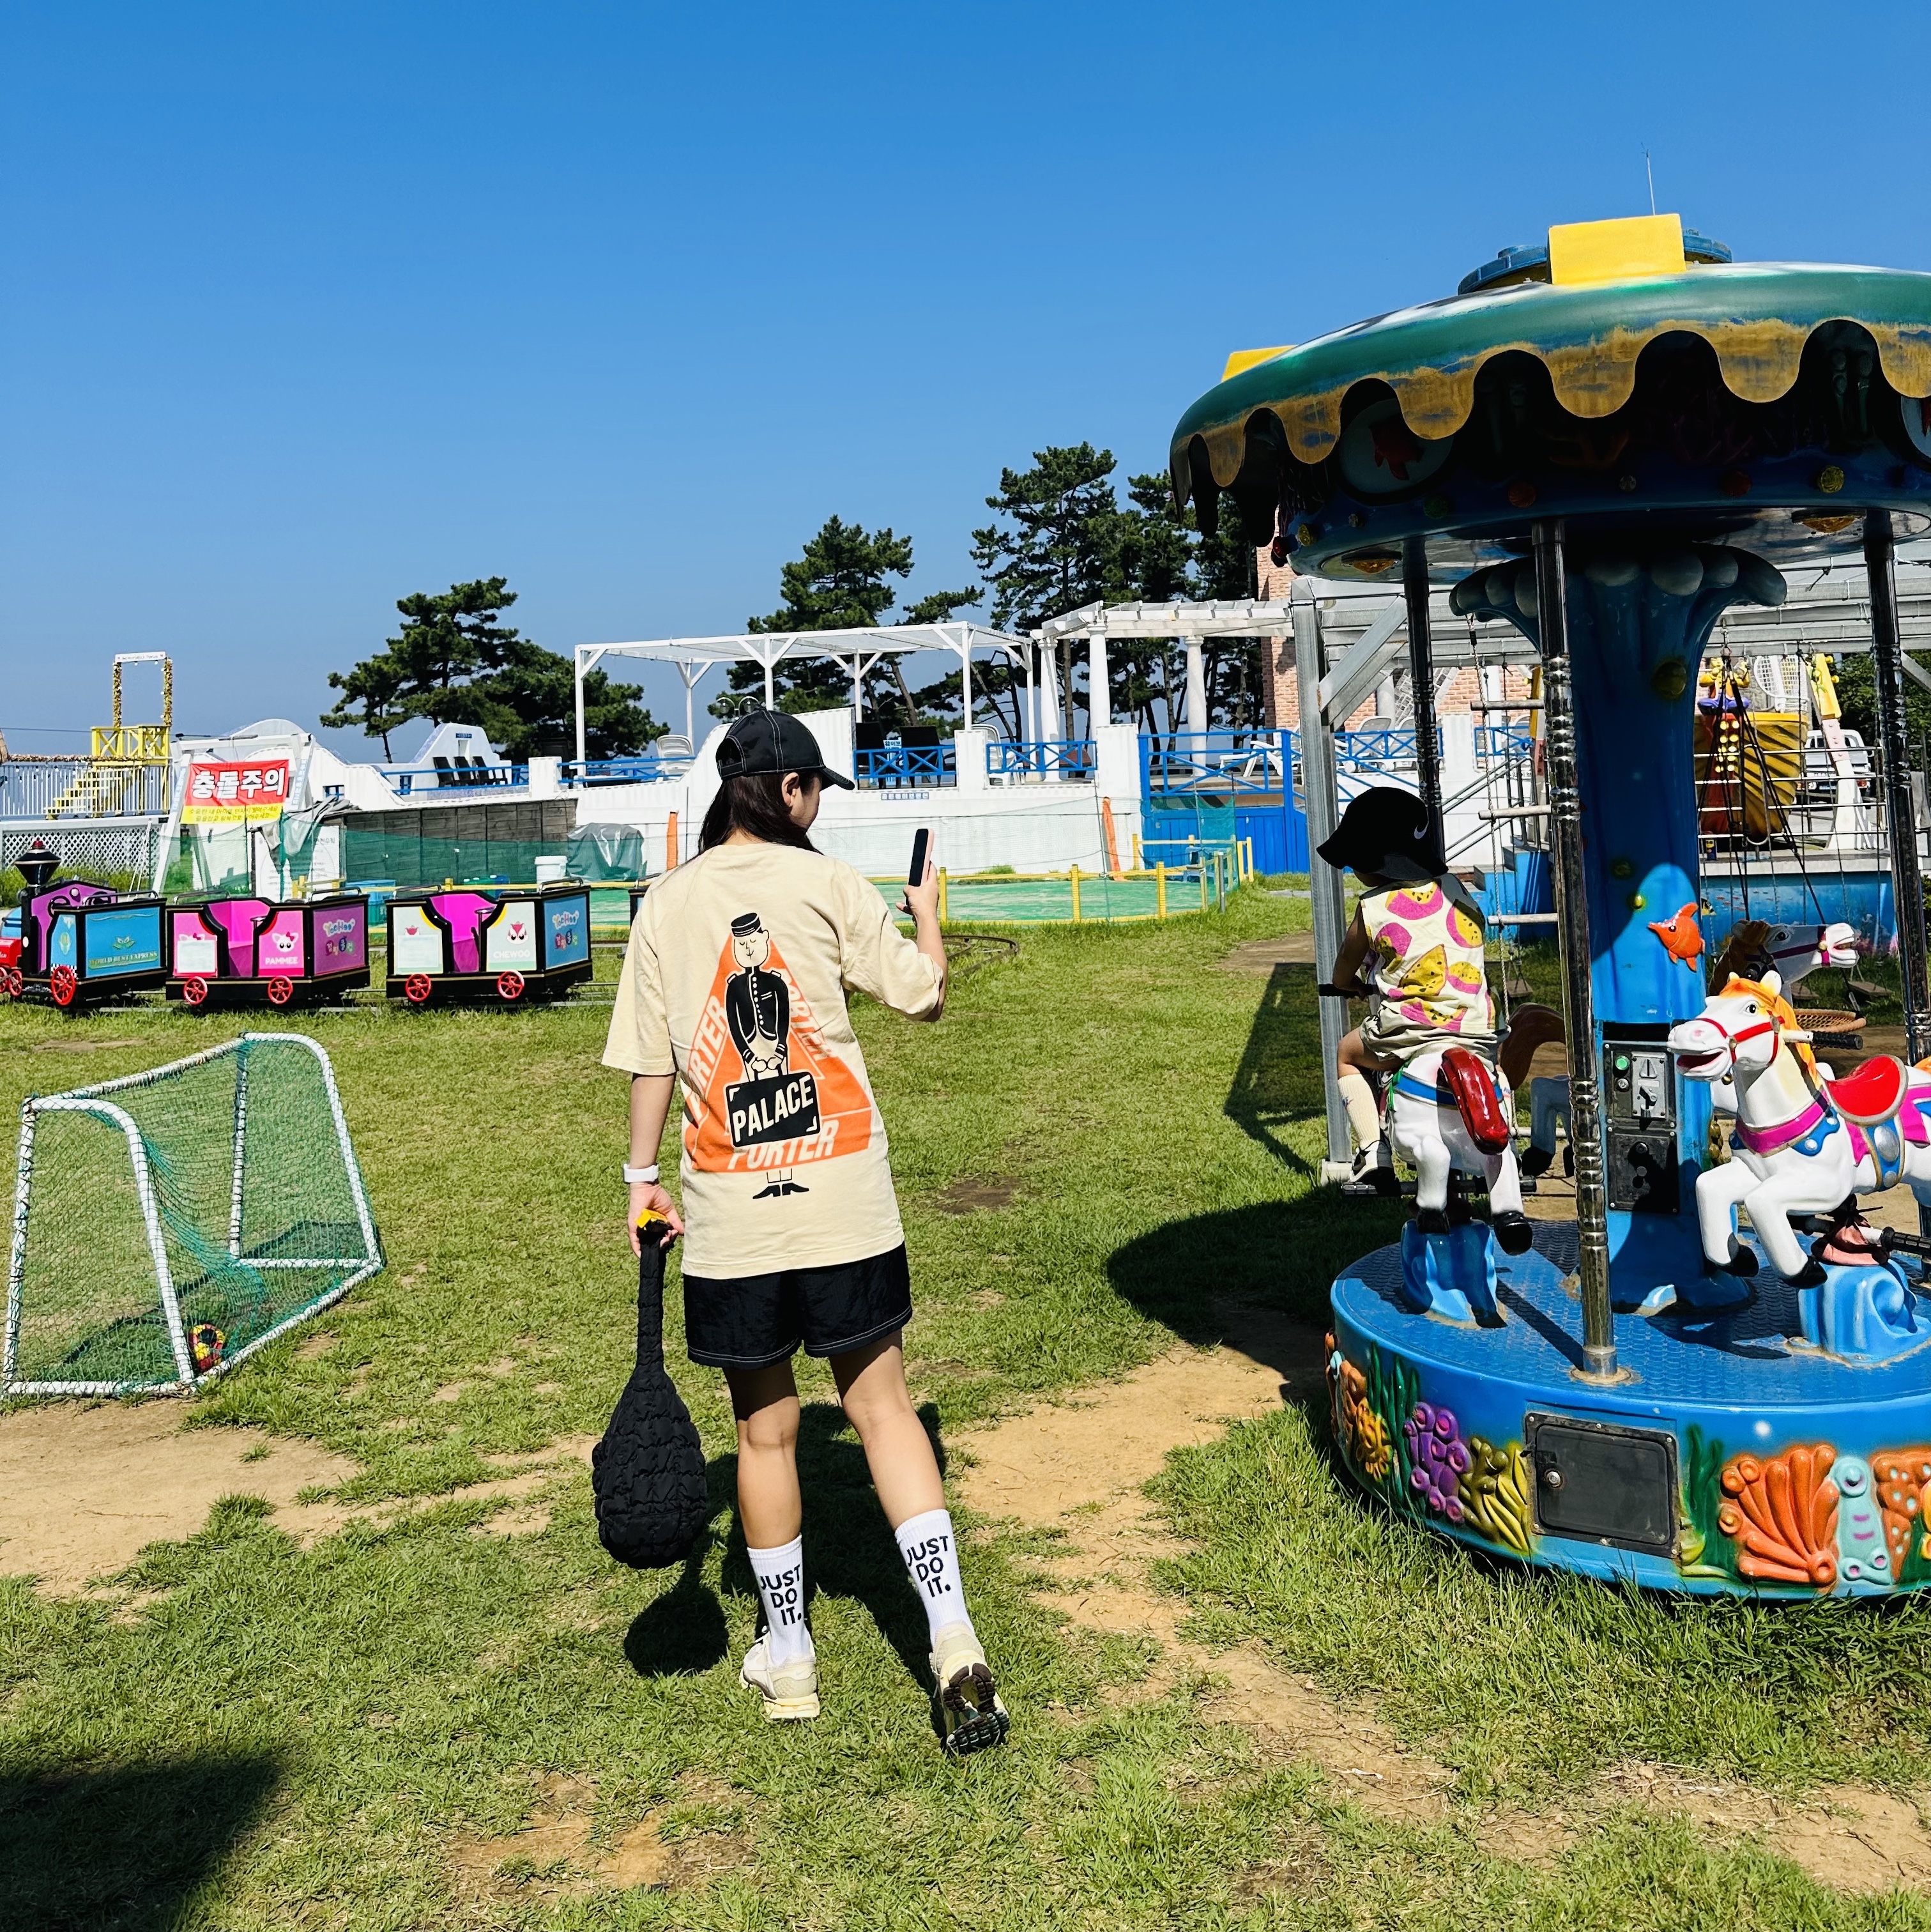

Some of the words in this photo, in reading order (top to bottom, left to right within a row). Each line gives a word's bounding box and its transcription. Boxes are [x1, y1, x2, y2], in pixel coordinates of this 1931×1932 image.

[192, 767, 286, 799] 충돌주의
[265, 956, 298, 965] PAMMEE
[493, 949, 530, 959] CHEWOO
[732, 1074, 814, 1143] PALACE
[906, 1535, 949, 1567] JUST
[759, 1563, 800, 1590] JUST
[915, 1556, 944, 1583] DO
[770, 1588, 798, 1608] DO
[927, 1575, 951, 1598] IT.
[781, 1606, 802, 1626] IT.
